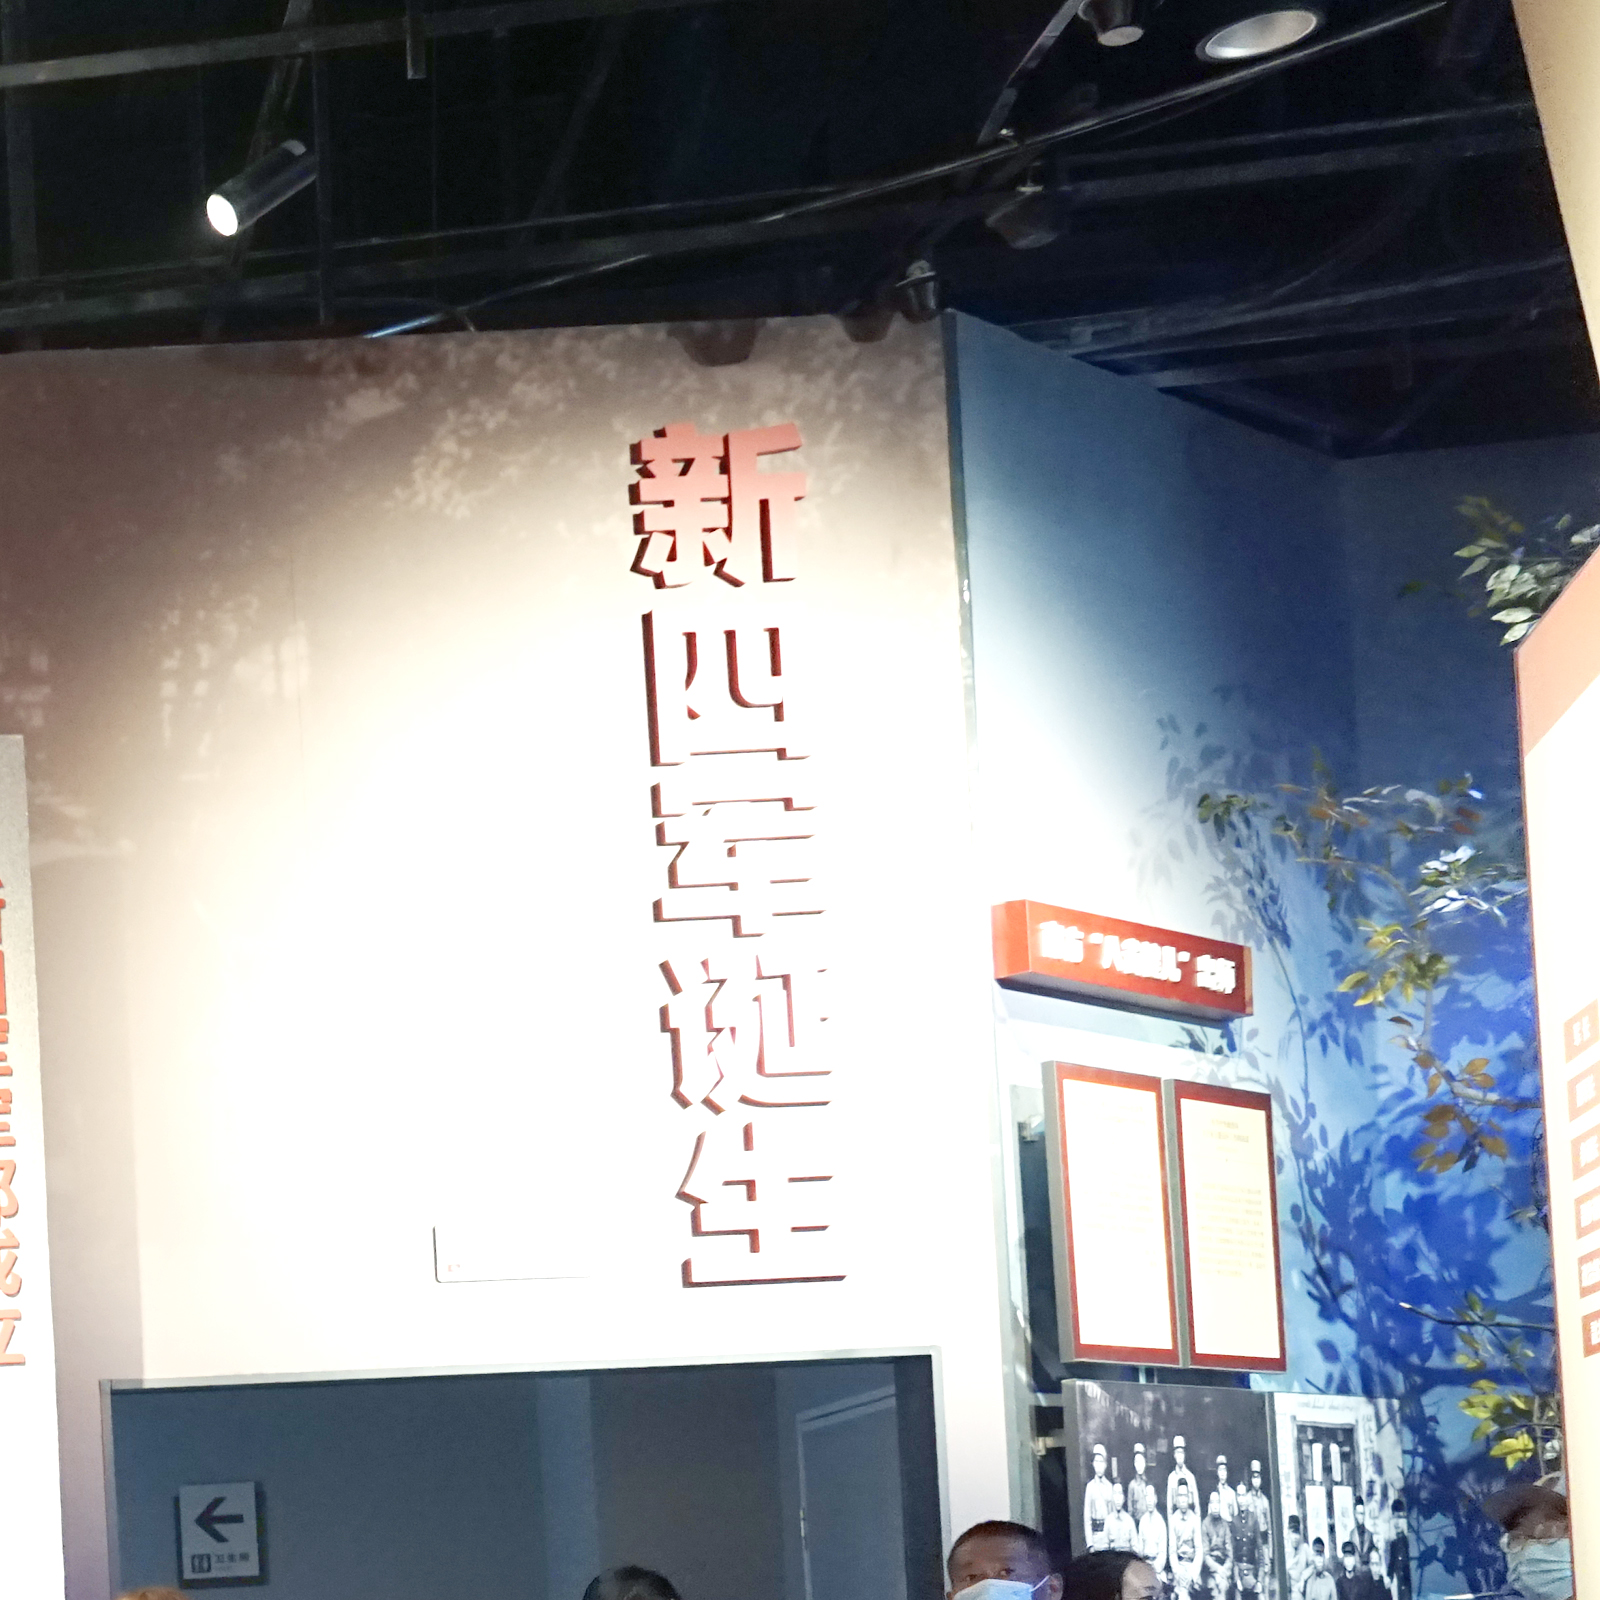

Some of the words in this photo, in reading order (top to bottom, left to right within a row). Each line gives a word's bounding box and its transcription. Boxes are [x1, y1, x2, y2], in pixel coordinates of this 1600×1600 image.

[629, 422, 846, 1288] 新四军诞生
